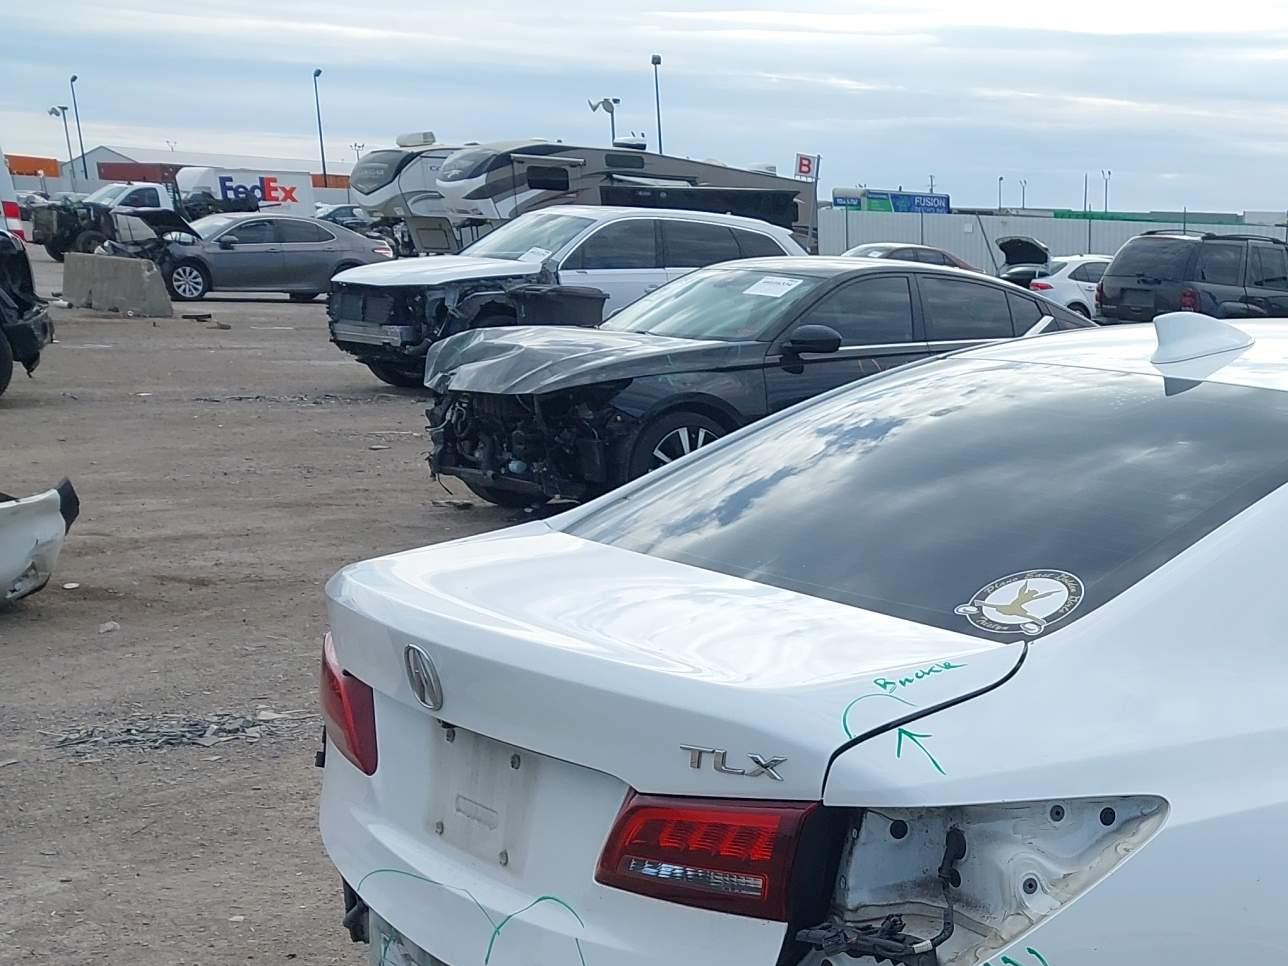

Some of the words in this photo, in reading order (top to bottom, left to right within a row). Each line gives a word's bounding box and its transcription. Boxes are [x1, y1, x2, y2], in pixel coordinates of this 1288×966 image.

[798, 156, 812, 174] B
[218, 176, 299, 203] FedEx
[914, 196, 946, 208] FUSION
[679, 743, 788, 782] TLX
